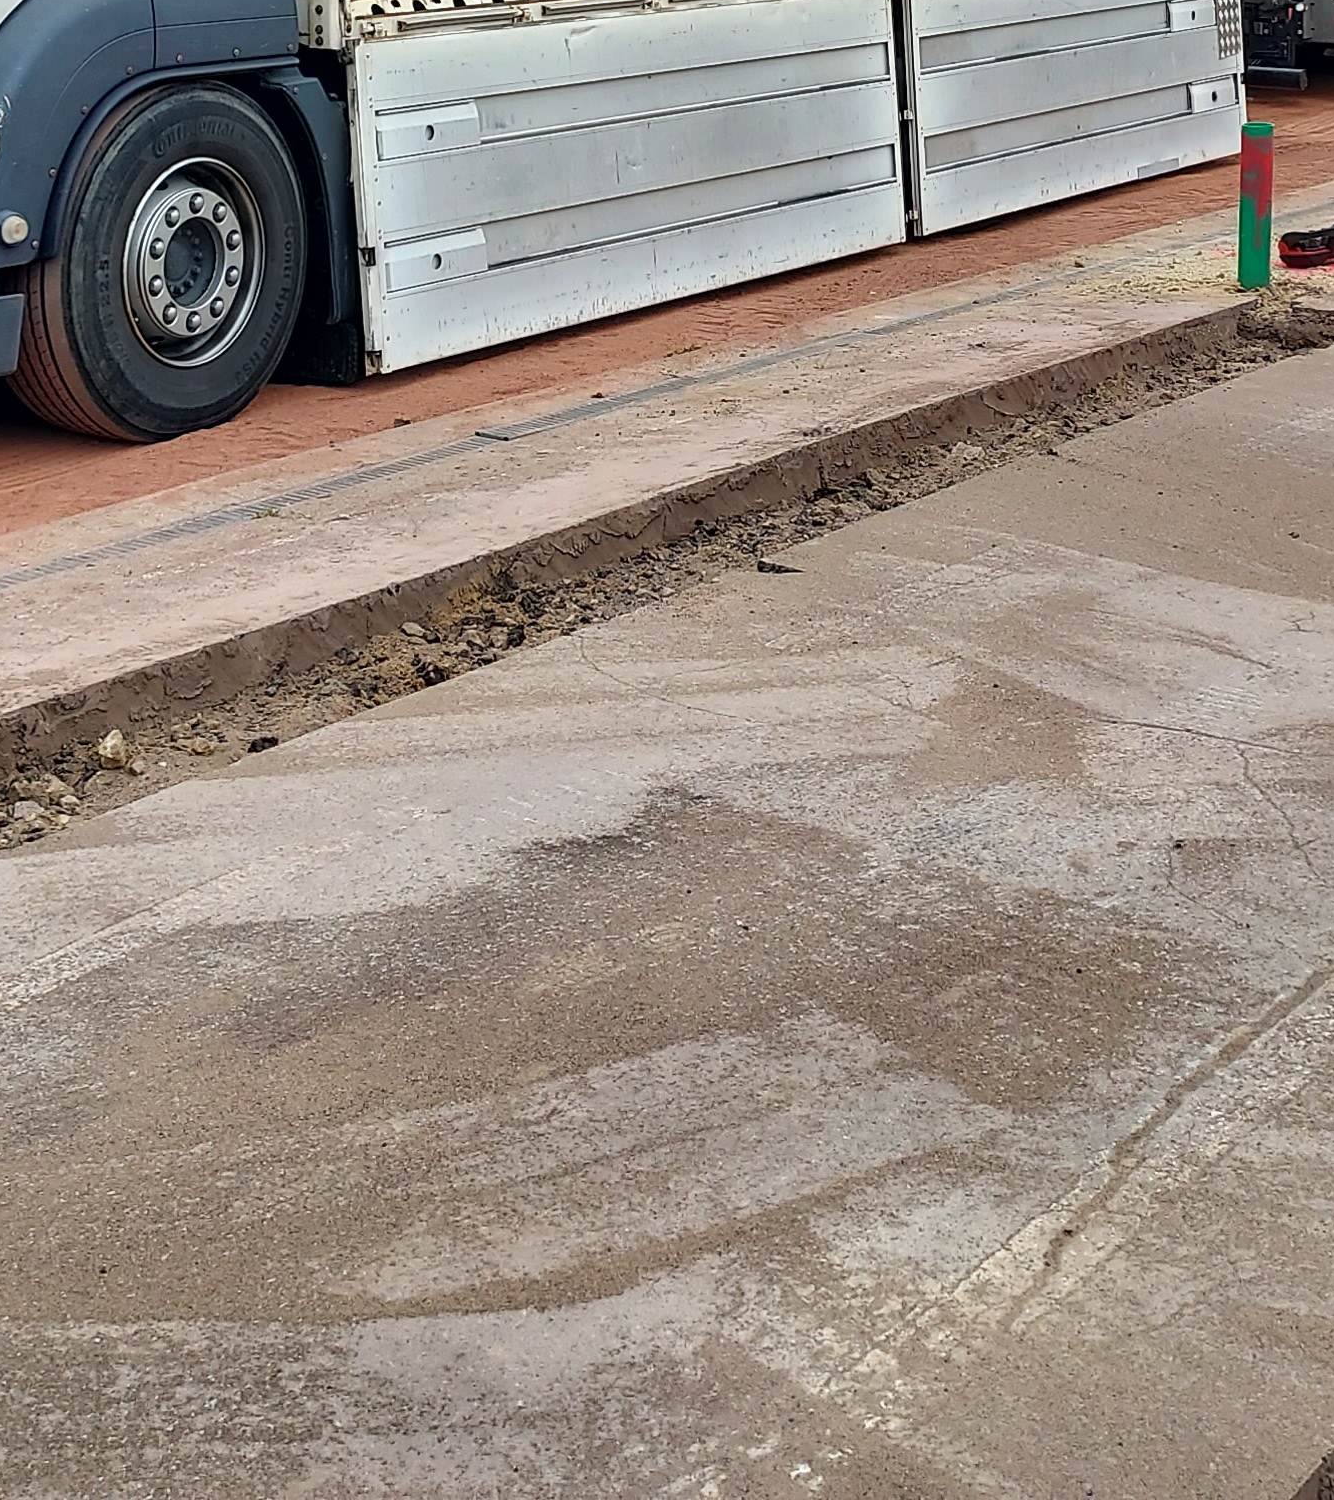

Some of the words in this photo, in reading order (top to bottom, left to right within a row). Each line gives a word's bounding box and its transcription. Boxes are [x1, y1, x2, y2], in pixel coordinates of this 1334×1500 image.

[152, 117, 236, 159] Contiental
[282, 222, 296, 281] Conti
[258, 287, 291, 353] Hybrid
